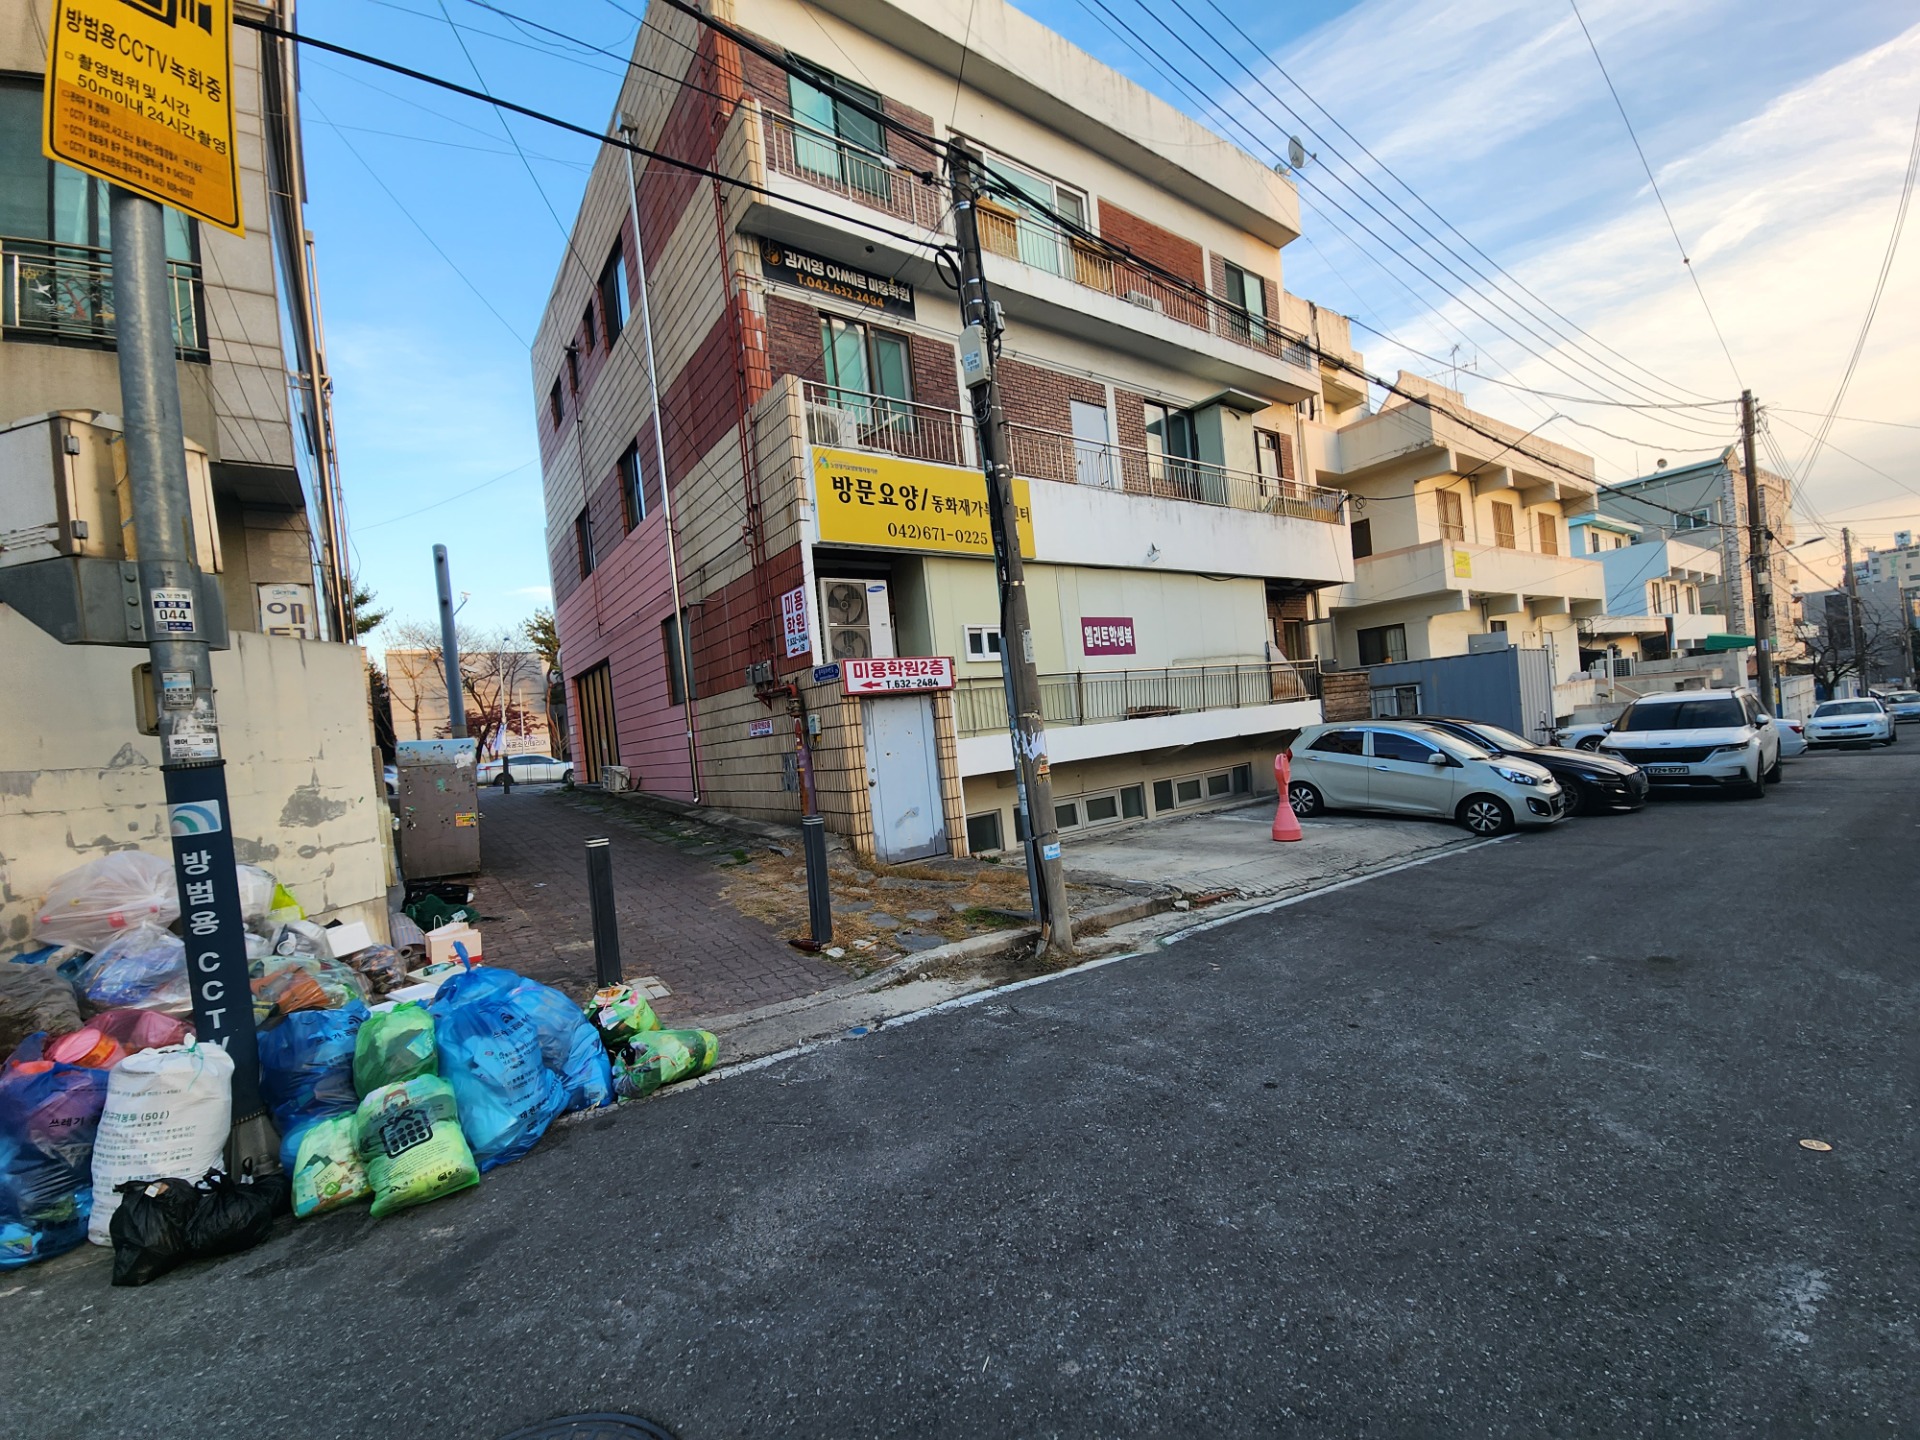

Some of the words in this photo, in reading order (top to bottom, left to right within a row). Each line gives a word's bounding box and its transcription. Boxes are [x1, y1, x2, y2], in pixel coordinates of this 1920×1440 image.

[78, 53, 140, 95] 촬영범위
[143, 85, 157, 100] 및
[161, 95, 190, 119] 시간
[784, 250, 824, 277] 김지영
[887, 522, 988, 545] 042)671-0225
[159, 609, 187, 620] 044
[1084, 625, 1133, 648] 엘리트학생복
[886, 678, 939, 689] T.632-2484
[182, 850, 220, 935] 방범용
[49, 1115, 86, 1128] 쓰레기
